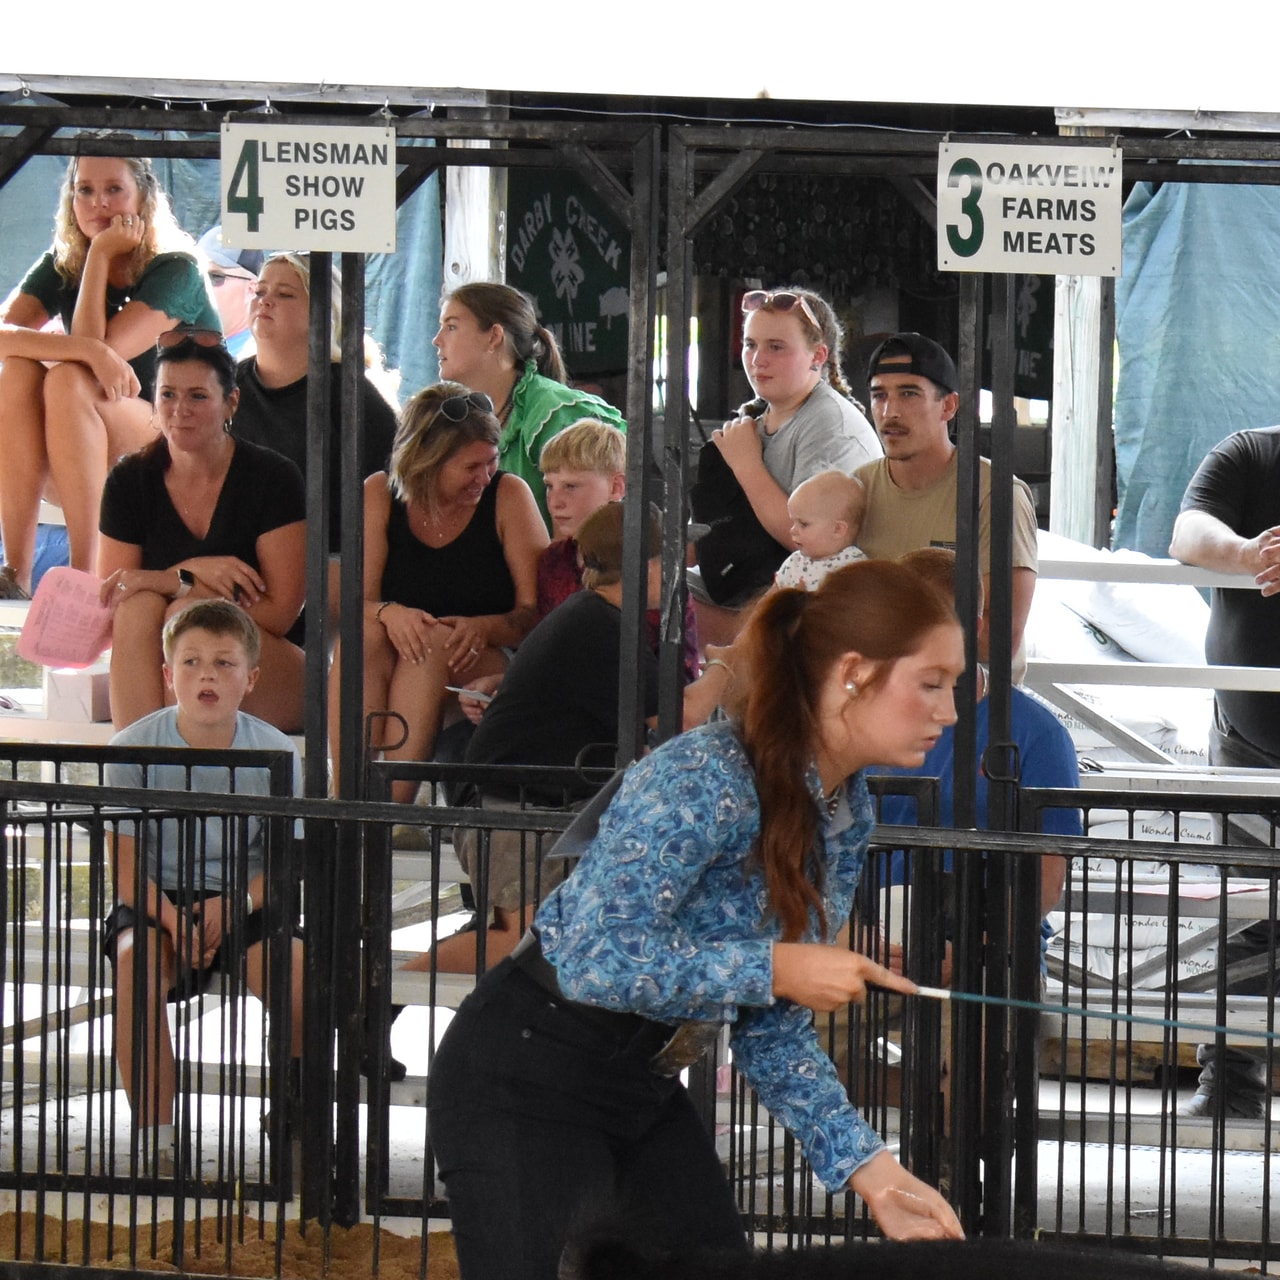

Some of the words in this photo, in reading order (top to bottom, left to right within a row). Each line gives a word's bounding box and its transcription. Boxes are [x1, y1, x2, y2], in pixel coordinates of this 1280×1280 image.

[261, 141, 388, 165] LENSMAN
[227, 139, 265, 232] 4
[285, 175, 365, 197] SHOW
[294, 208, 356, 231] PIGS
[946, 157, 985, 258] 3
[1002, 197, 1097, 222] FARMS
[510, 192, 552, 273] DARBY
[566, 195, 623, 272] CREEK
[1003, 231, 1096, 256] MEATS
